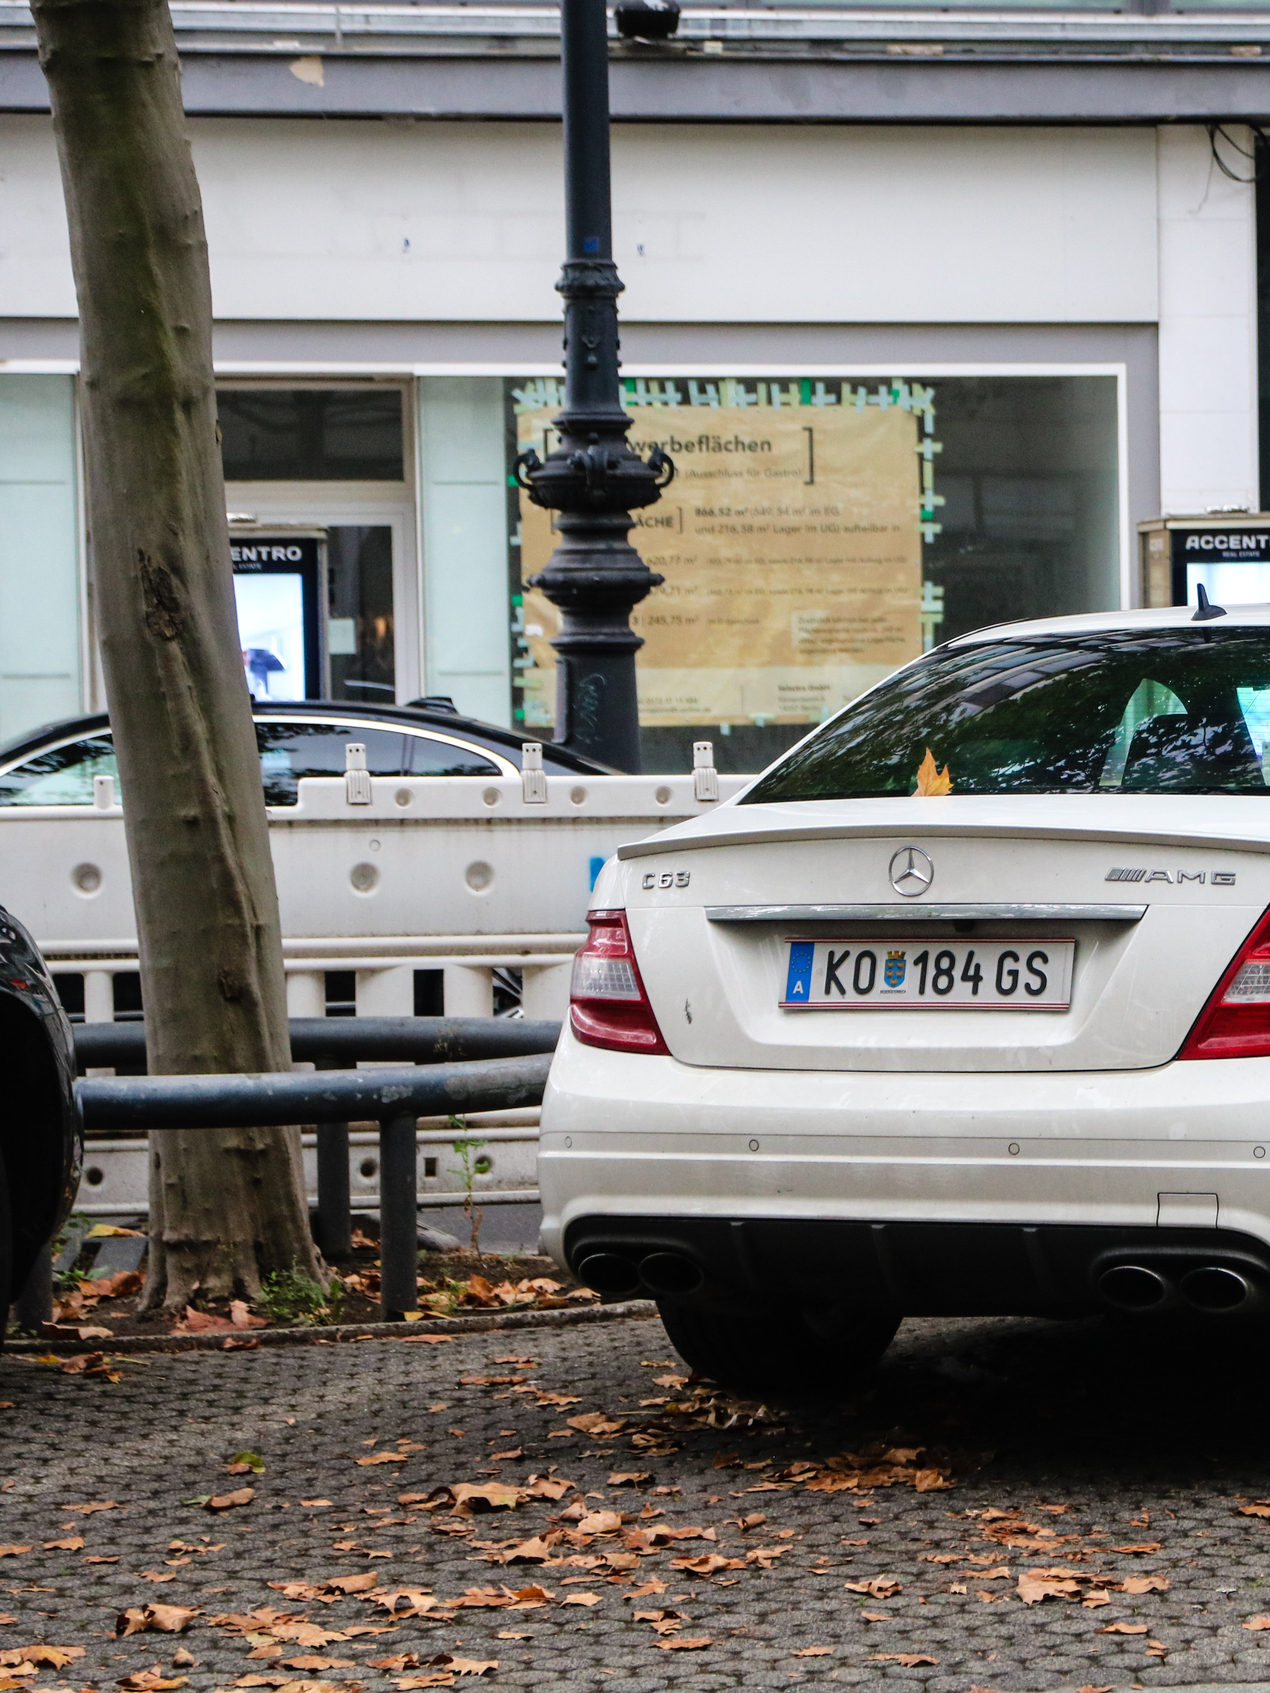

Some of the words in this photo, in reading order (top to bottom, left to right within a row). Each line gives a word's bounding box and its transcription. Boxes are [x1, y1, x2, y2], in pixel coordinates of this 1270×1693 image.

[642, 871, 690, 890] C63
[1144, 869, 1236, 885] AMG
[824, 950, 877, 995] KO
[913, 950, 983, 995] 184
[995, 950, 1049, 995] GS
[792, 980, 804, 994] A
